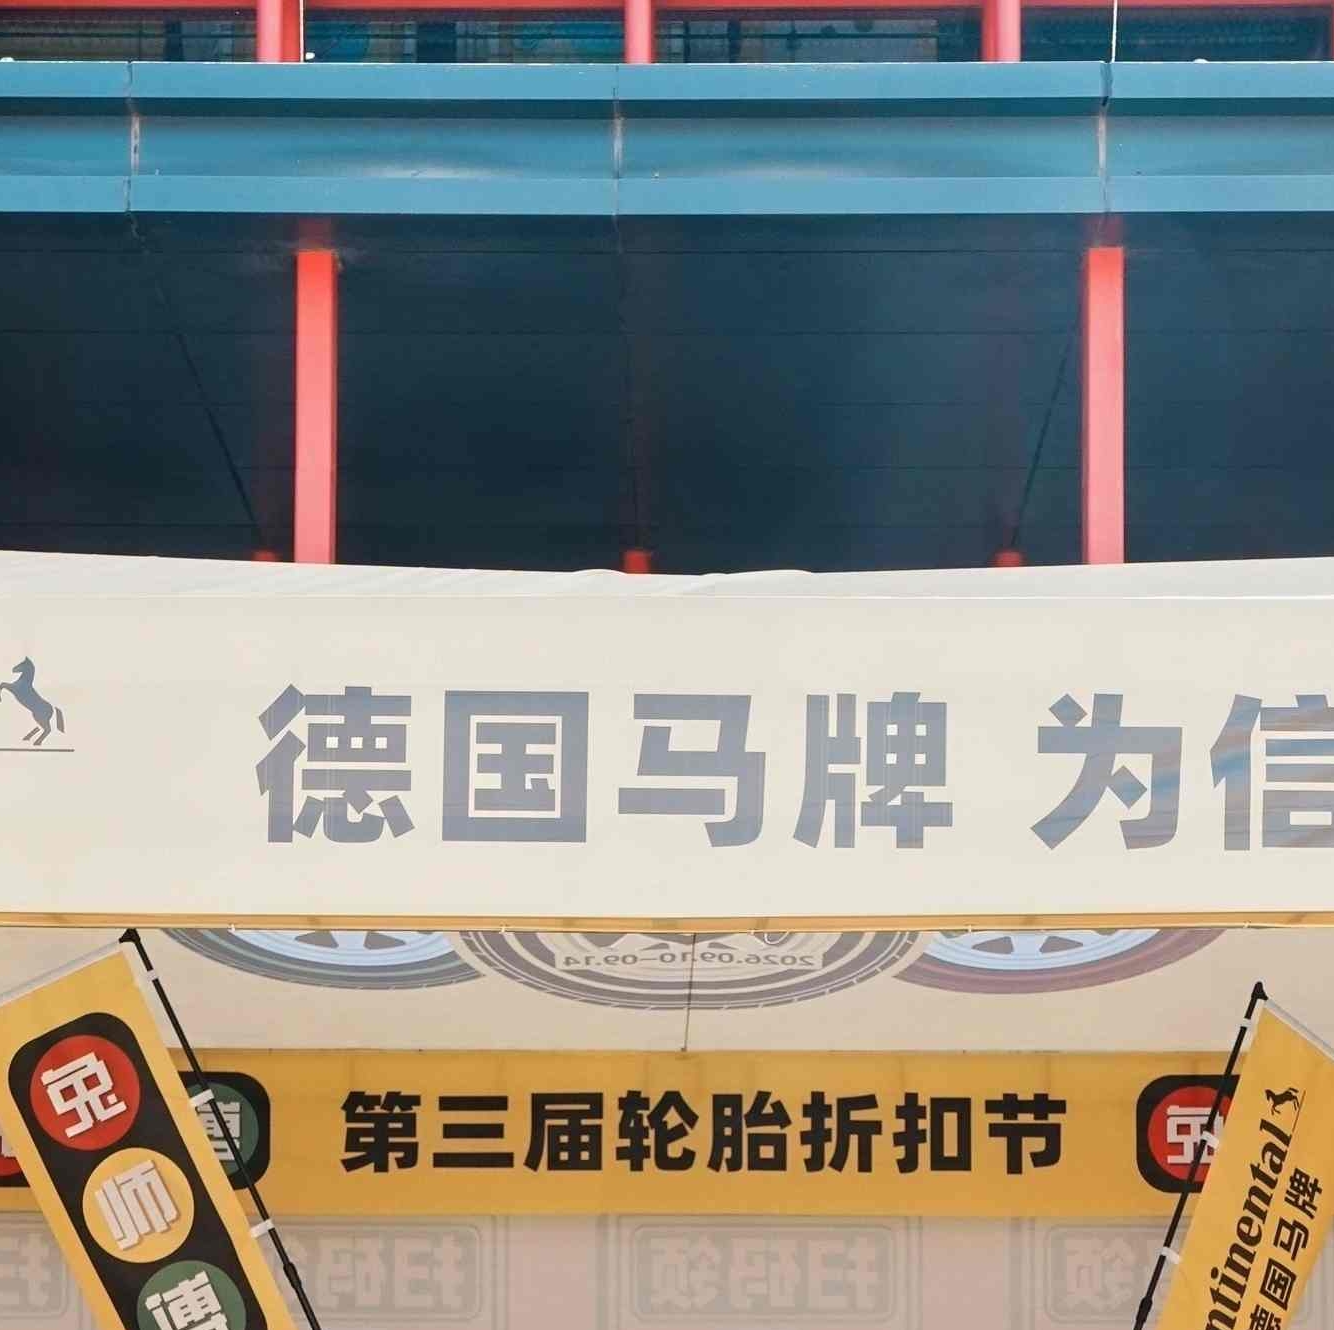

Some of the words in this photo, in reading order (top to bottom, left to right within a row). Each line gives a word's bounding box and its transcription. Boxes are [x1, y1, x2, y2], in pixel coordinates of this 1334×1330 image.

[255, 683, 954, 850] 德国马牌
[339, 1089, 1067, 1175] 第三届轮胎折扣节
